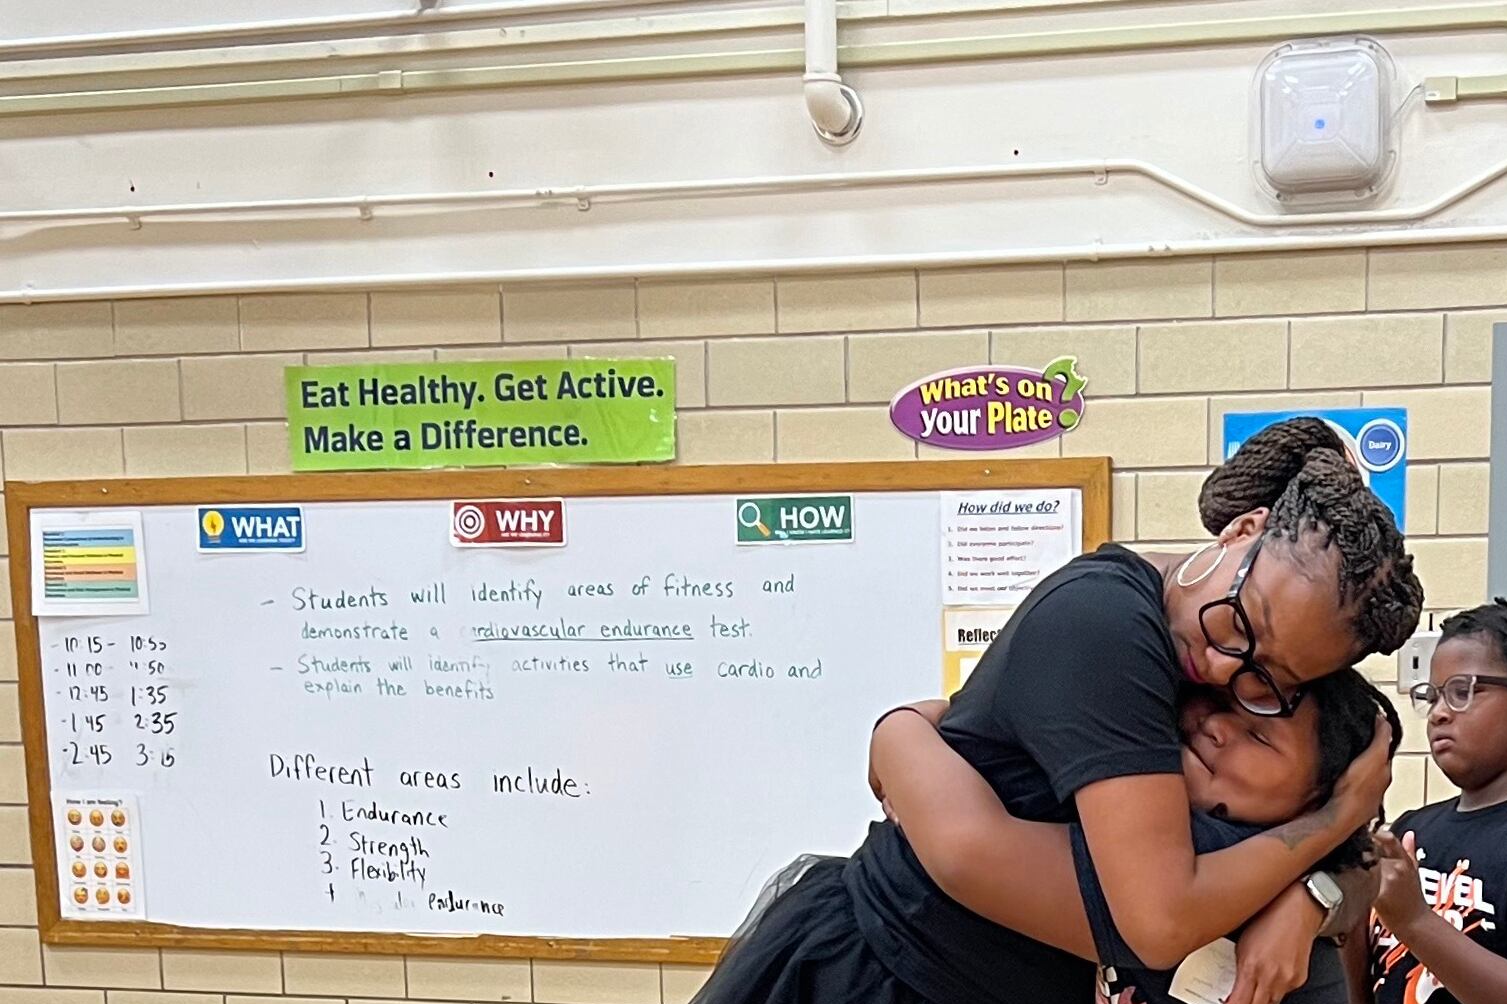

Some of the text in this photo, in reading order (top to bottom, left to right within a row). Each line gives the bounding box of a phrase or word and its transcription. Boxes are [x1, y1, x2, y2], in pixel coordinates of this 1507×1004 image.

[301, 368, 664, 410] Eat Healthy. Get Active.
[920, 373, 1053, 405] What's on
[920, 407, 982, 438] your
[987, 401, 1053, 435] Plate
[304, 419, 588, 453] Make a Difference.
[1367, 440, 1392, 451] Dairy
[495, 510, 555, 532] WHY
[780, 505, 845, 529] HOW
[958, 500, 1061, 514] How did we do?
[231, 516, 300, 538] WHAT
[291, 573, 795, 611] Students will identify areas of fitness and
[301, 621, 409, 641] demonstrate
[430, 627, 440, 640] a
[600, 618, 693, 638] endurance
[297, 654, 371, 674] Students
[388, 655, 412, 671] will
[512, 654, 589, 672] activities
[608, 652, 648, 672] that
[666, 663, 693, 677] use
[717, 658, 775, 679] cardio
[787, 658, 823, 680] and
[131, 685, 168, 707] 1:35
[304, 678, 494, 700] explain the benefits
[269, 753, 593, 799] Different areas include:
[342, 799, 449, 828] Endurance
[349, 831, 430, 865] Strength
[1418, 866, 1495, 915] EVEL
